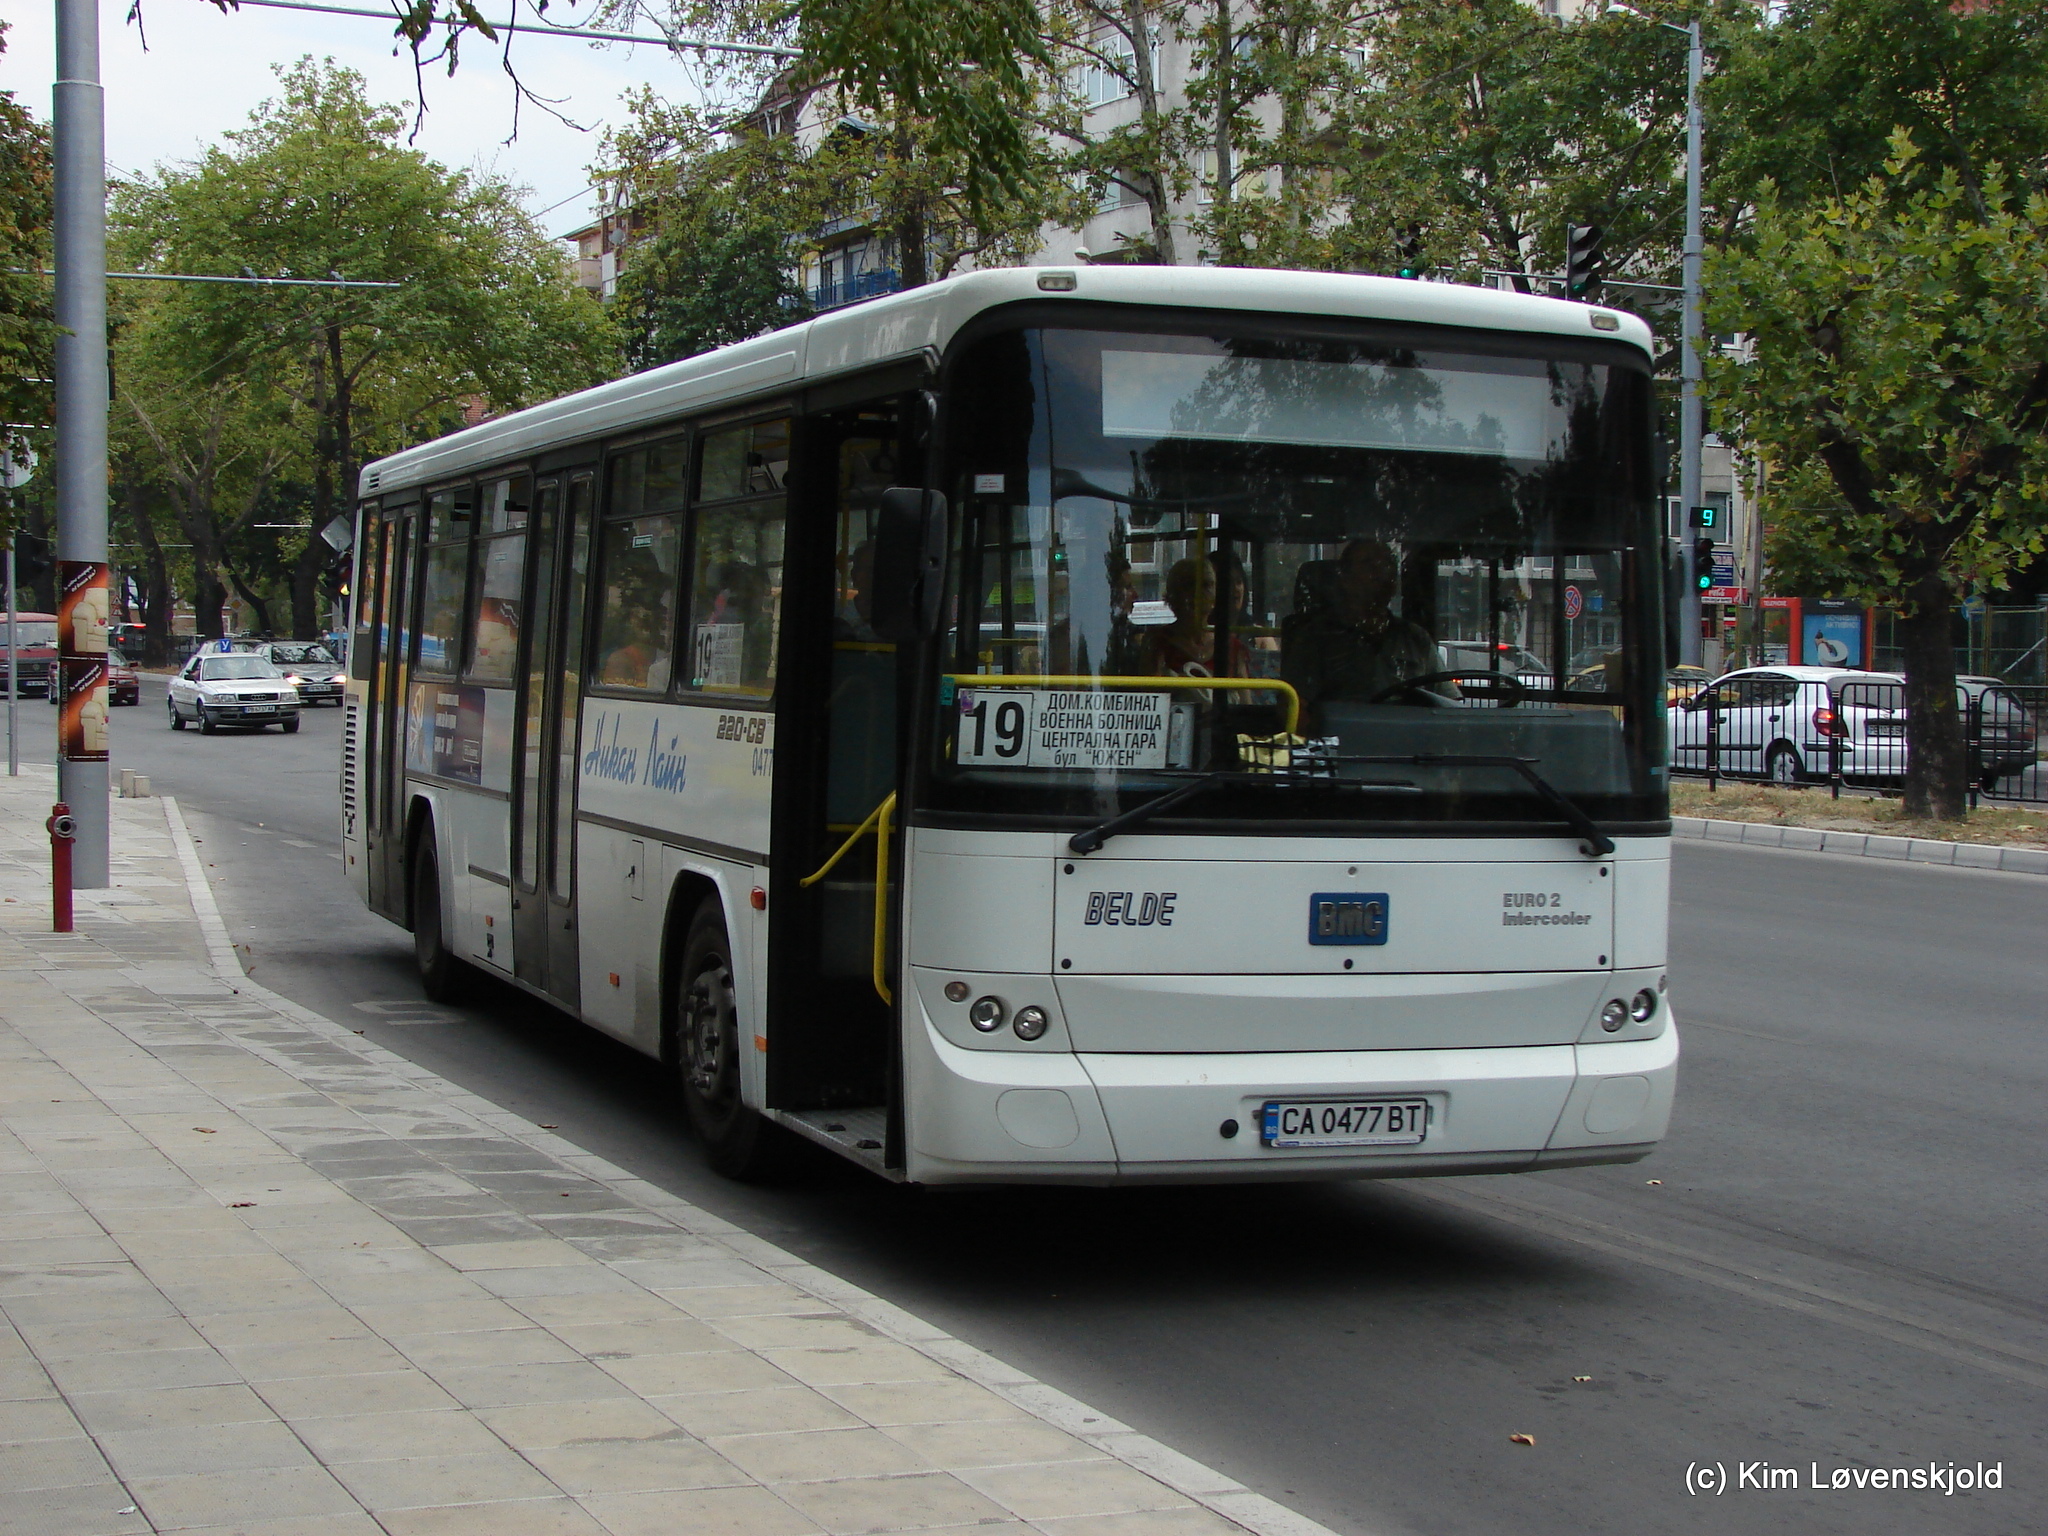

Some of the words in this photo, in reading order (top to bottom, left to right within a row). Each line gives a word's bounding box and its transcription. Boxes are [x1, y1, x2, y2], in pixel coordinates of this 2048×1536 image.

[1703, 509, 1713, 526] 9
[698, 632, 712, 679] 19
[1047, 693, 1159, 712] ДОМ.КОМБИНАТ
[964, 700, 1025, 758] 19
[1040, 712, 1093, 729] ВОЕННА
[1098, 713, 1162, 731] БОЛНИЦА
[1042, 731, 1120, 750] ЦЕНТРАЛНА
[1125, 733, 1156, 749] ГАРА
[1054, 749, 1076, 768] бул
[1084, 891, 1177, 926] BELDE
[1502, 892, 1547, 908] EURO
[1550, 892, 1561, 907] 2
[1318, 901, 1383, 937] BMC
[1502, 911, 1592, 926] Intercooler
[1282, 1107, 1315, 1135] CA
[1322, 1106, 1383, 1134] 0477
